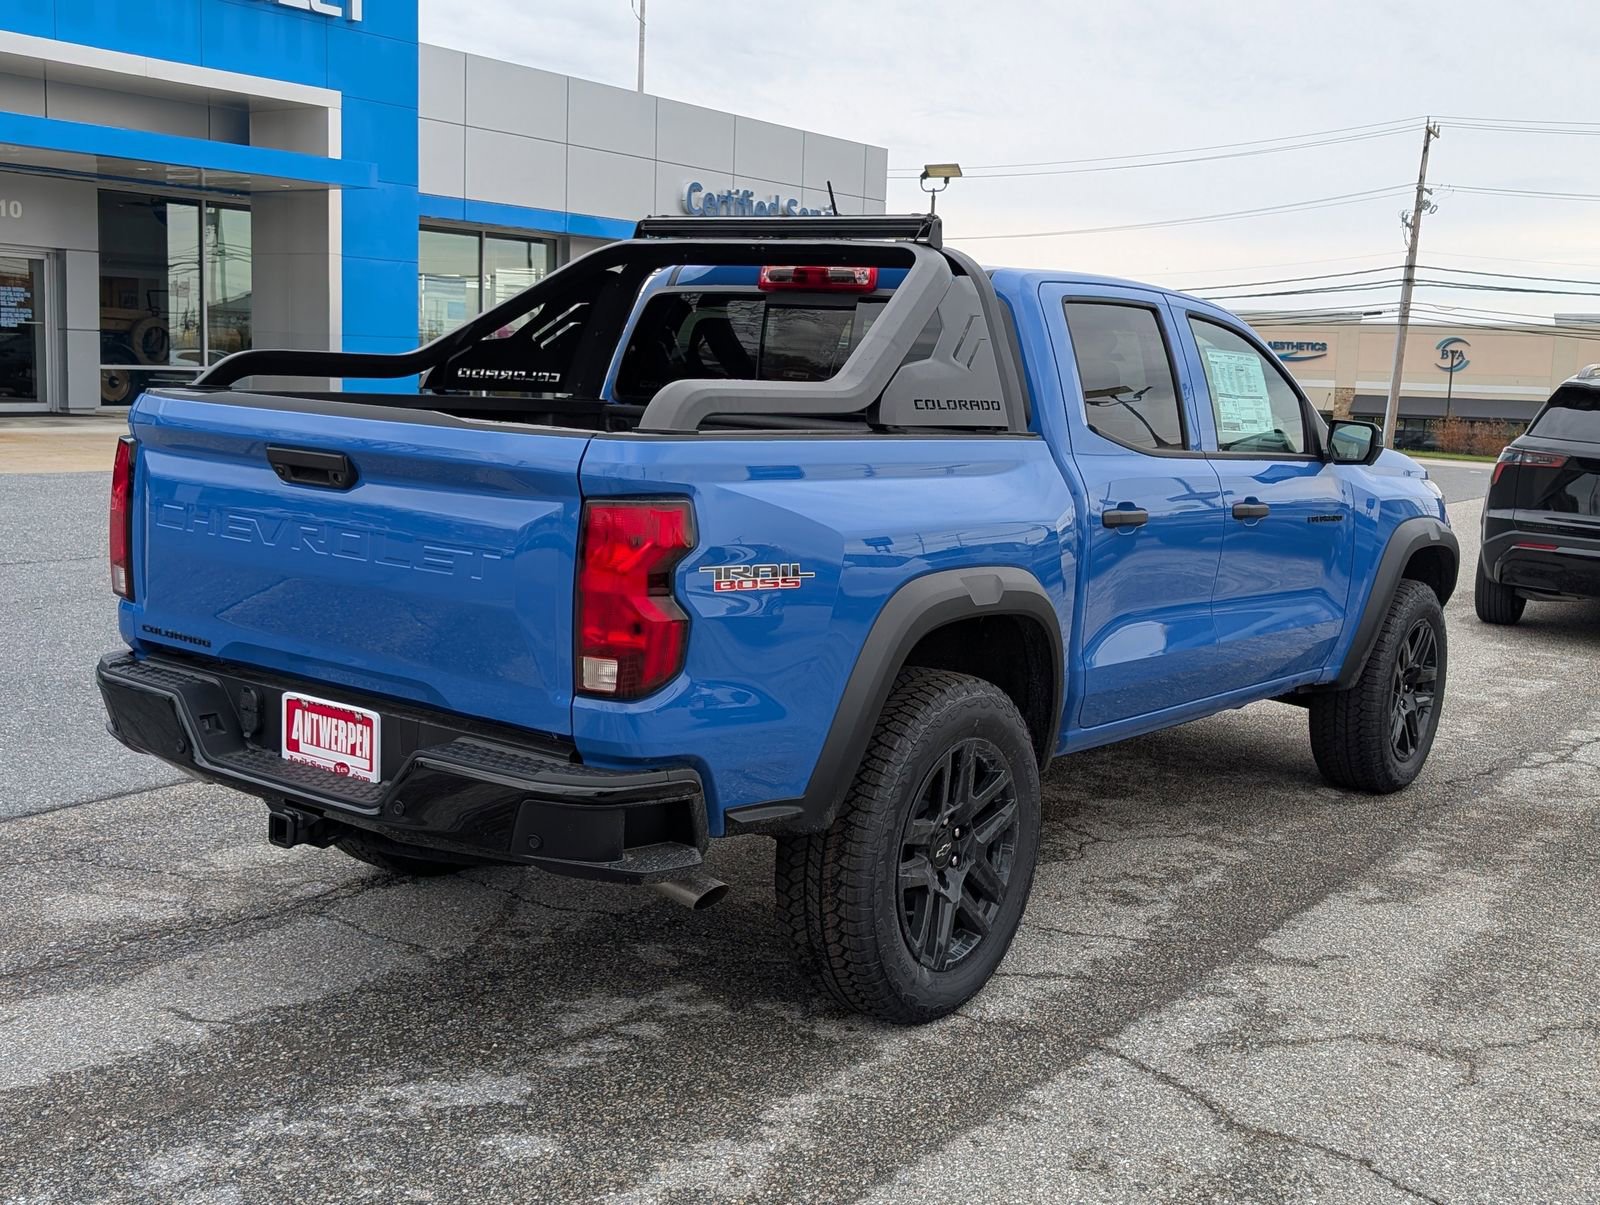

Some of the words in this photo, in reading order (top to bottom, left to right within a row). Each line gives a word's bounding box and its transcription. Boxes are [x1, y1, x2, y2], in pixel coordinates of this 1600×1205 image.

[683, 182, 780, 216] Certified
[1267, 341, 1328, 351] AESTHETICS
[914, 399, 1001, 411] COLORADO
[156, 503, 502, 581] CHEVROLET
[699, 563, 815, 581] TRAIL
[714, 577, 801, 592] BOSS
[142, 624, 211, 648] COLORADO
[291, 708, 370, 760] ANTWERPEN
